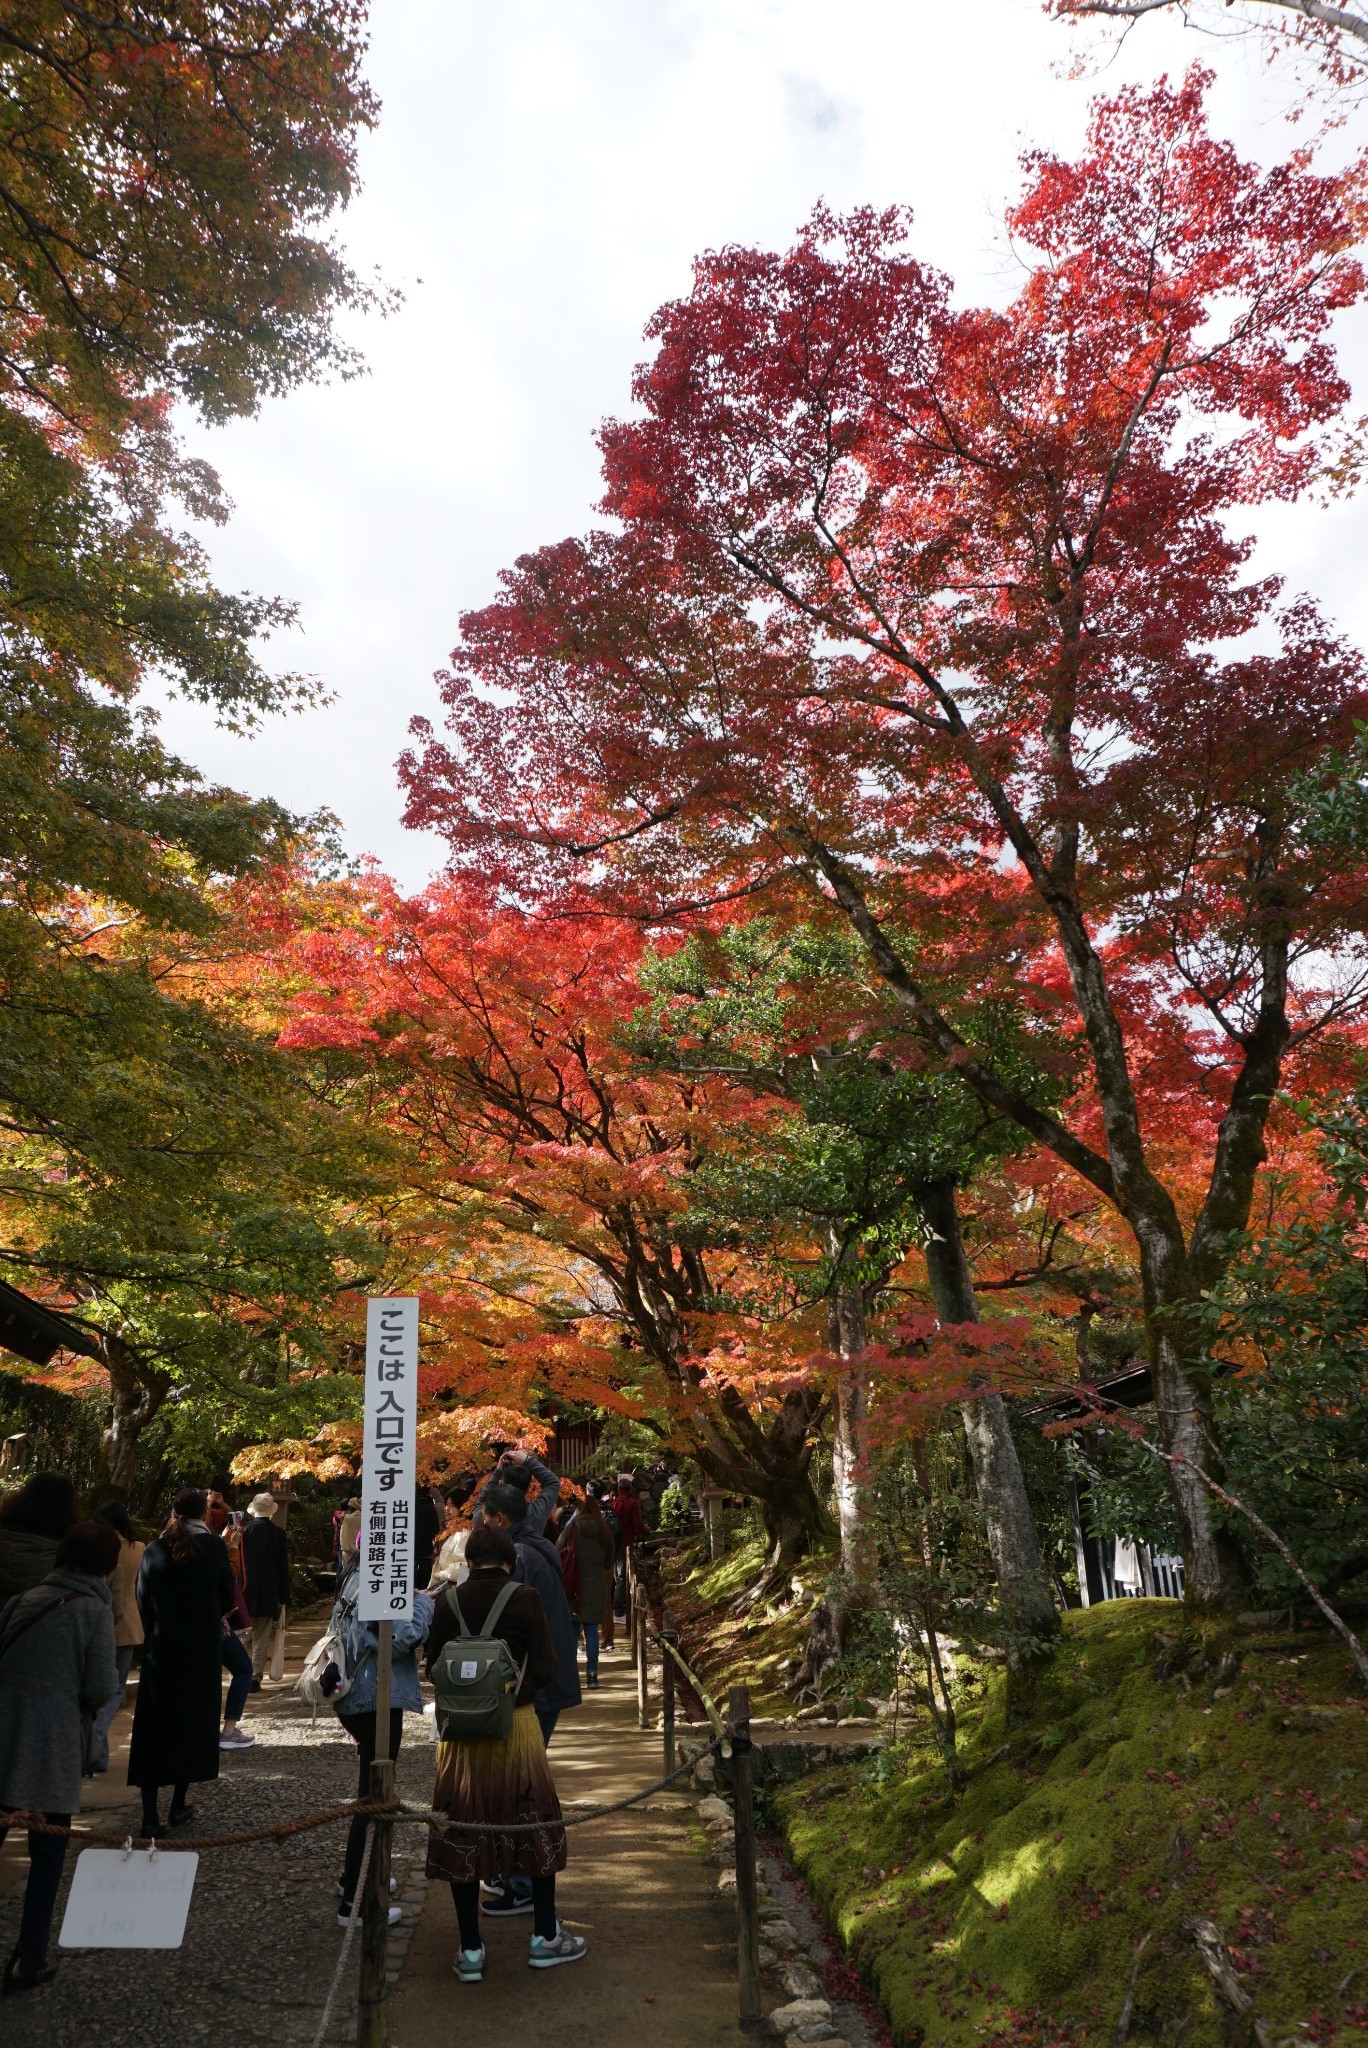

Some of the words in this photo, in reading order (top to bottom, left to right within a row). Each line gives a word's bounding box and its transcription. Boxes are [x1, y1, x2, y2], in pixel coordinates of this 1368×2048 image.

[368, 1500, 387, 1594] 右側通路です
[390, 1500, 409, 1610] 出口は仁王門の
